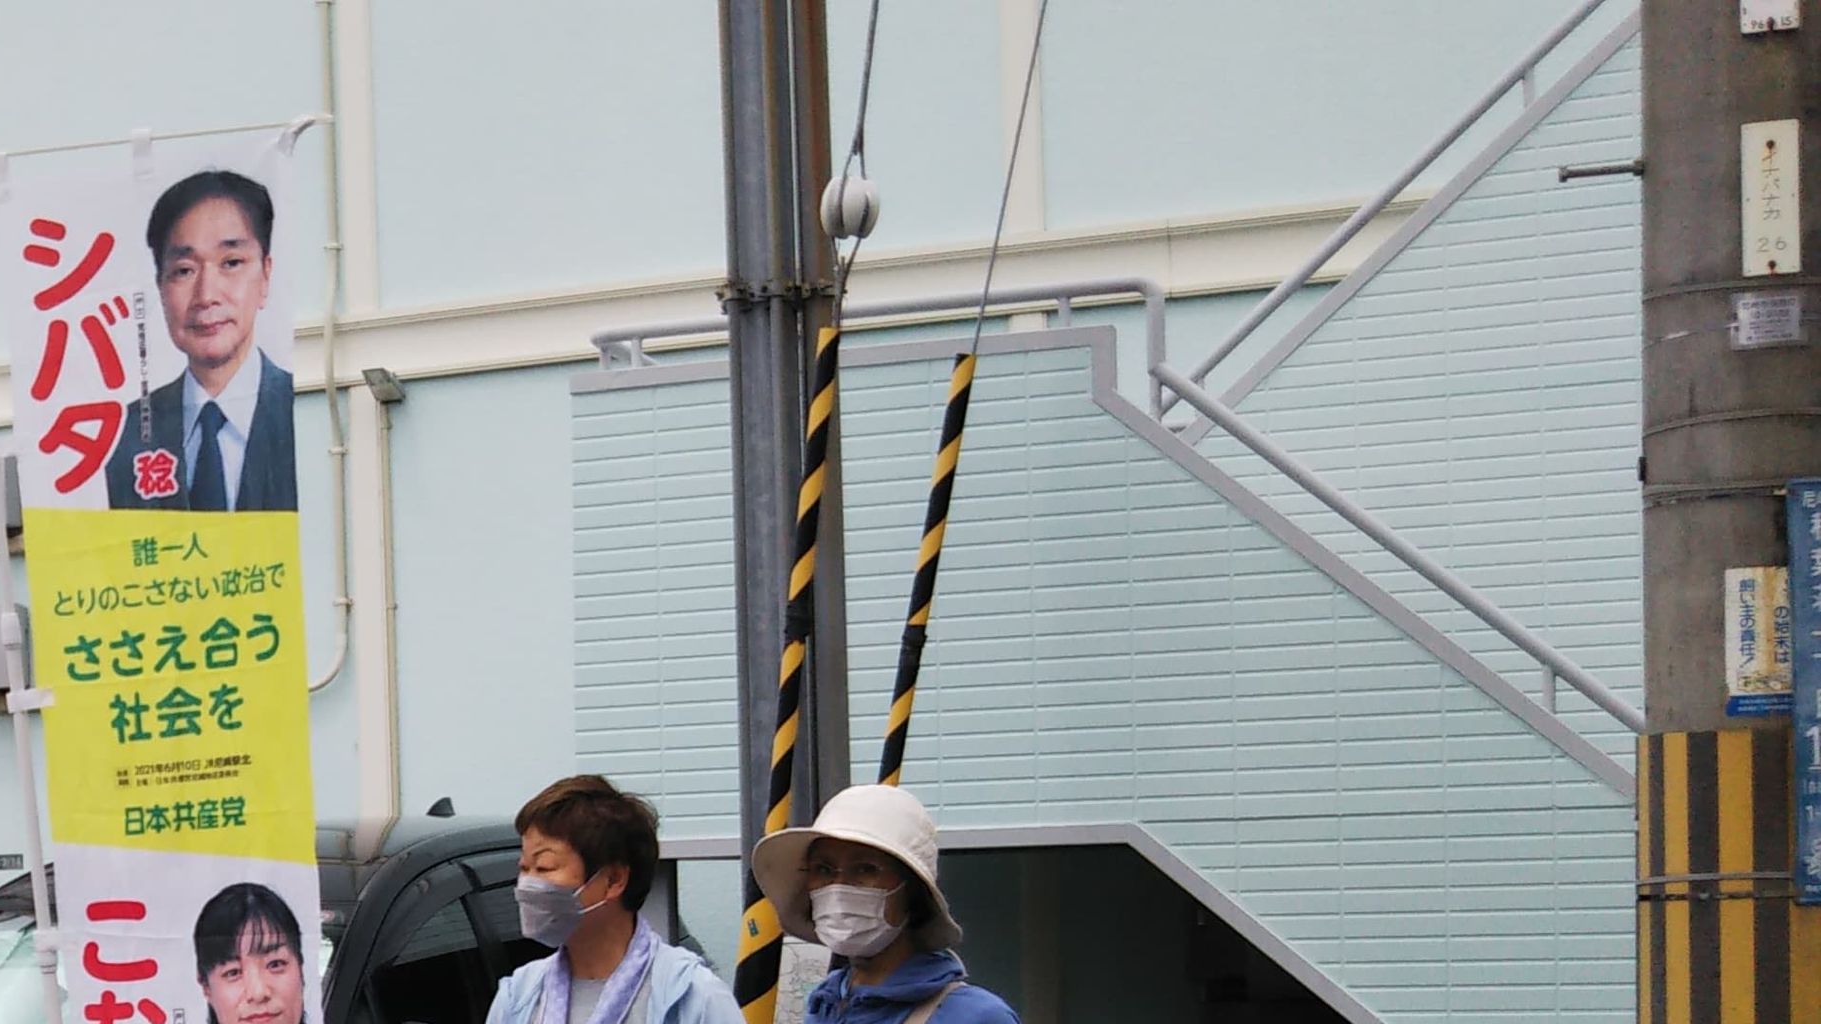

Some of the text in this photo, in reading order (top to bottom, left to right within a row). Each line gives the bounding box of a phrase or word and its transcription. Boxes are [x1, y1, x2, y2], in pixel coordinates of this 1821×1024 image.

[23, 218, 130, 494] シバタ
[136, 452, 176, 497] 稔
[132, 532, 208, 567] 誰一人
[53, 562, 285, 617] とりのこさない政治で
[63, 614, 280, 681] ささえ合う
[109, 684, 244, 743] 社会を
[124, 796, 246, 836] 日本共産党
